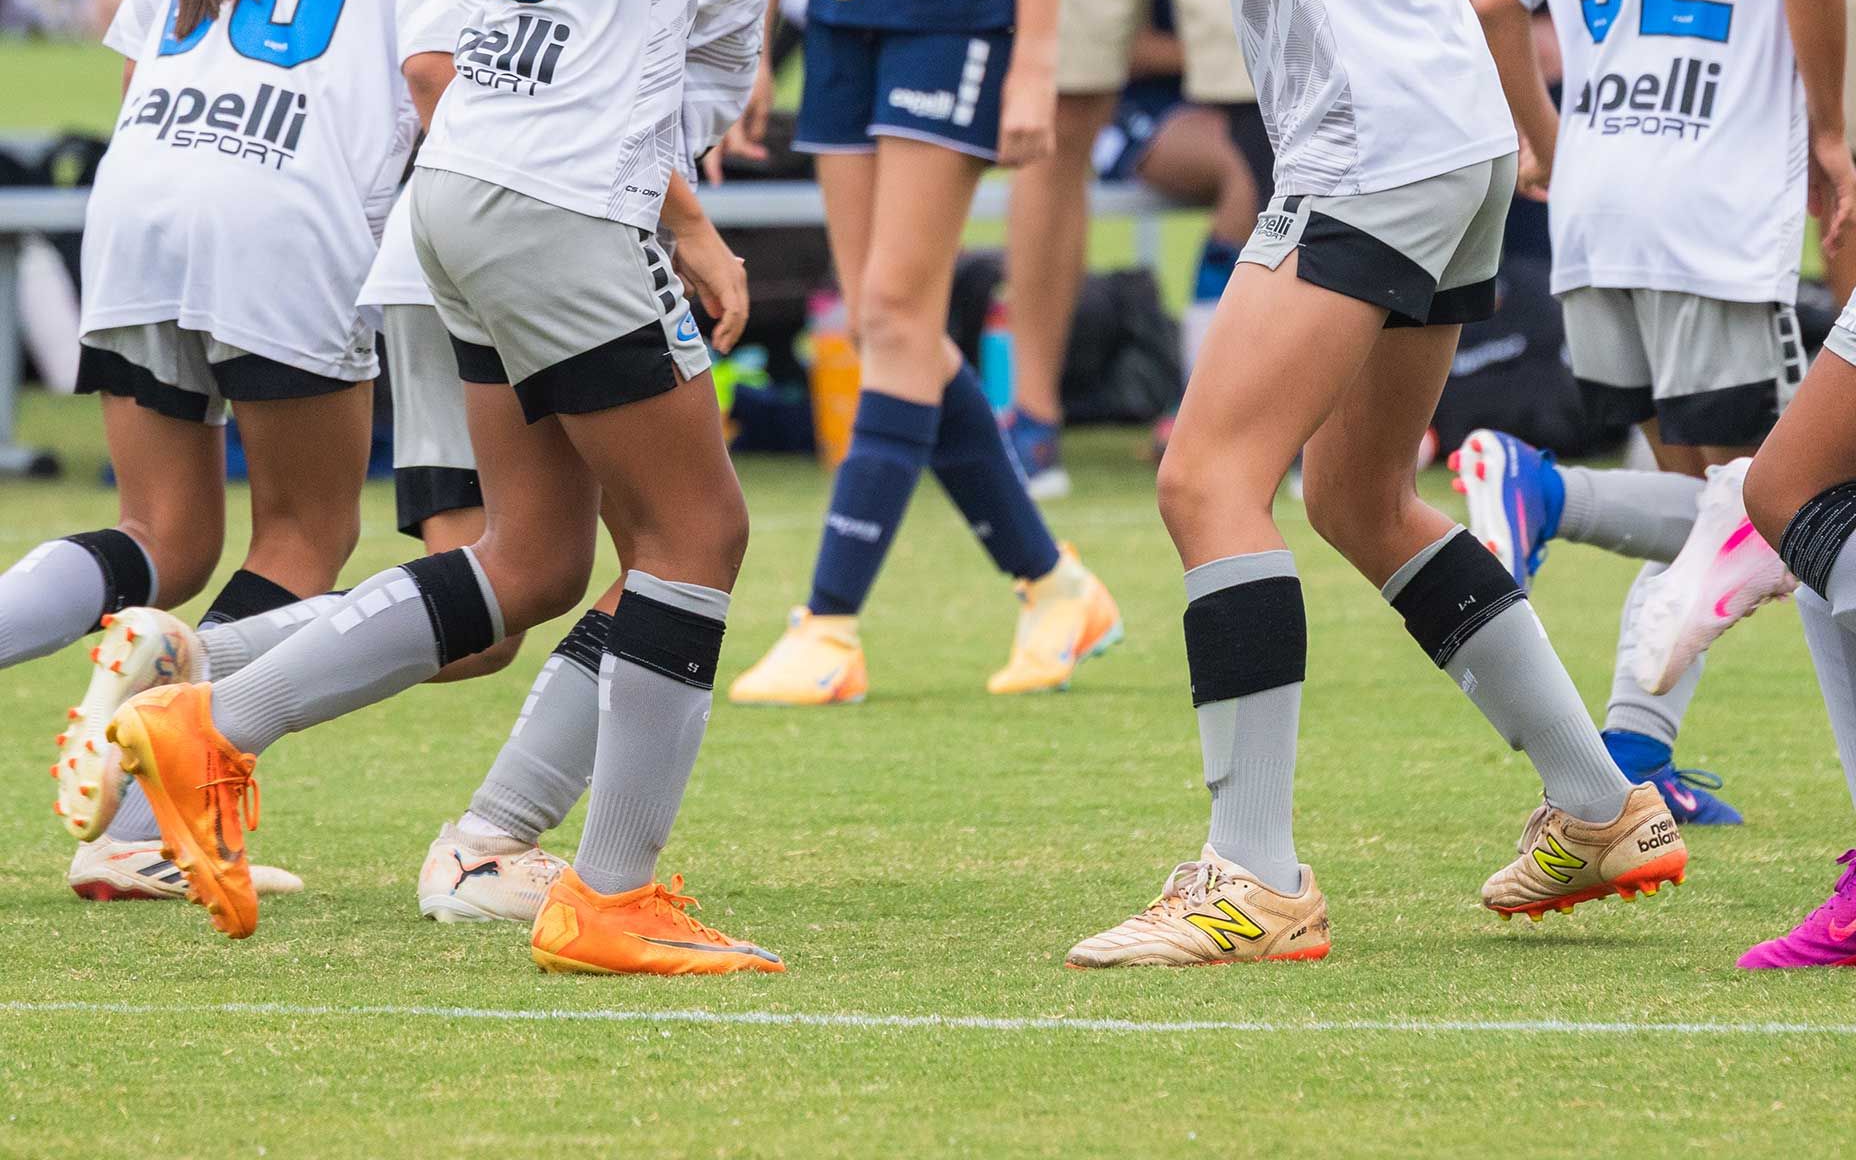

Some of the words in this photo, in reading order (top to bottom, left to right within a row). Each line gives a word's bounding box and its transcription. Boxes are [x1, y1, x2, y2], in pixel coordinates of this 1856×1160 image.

[171, 129, 295, 171] SPORT
[1602, 116, 1711, 140] SPORT
[1532, 834, 1587, 884] N
[1183, 898, 1266, 952] N
